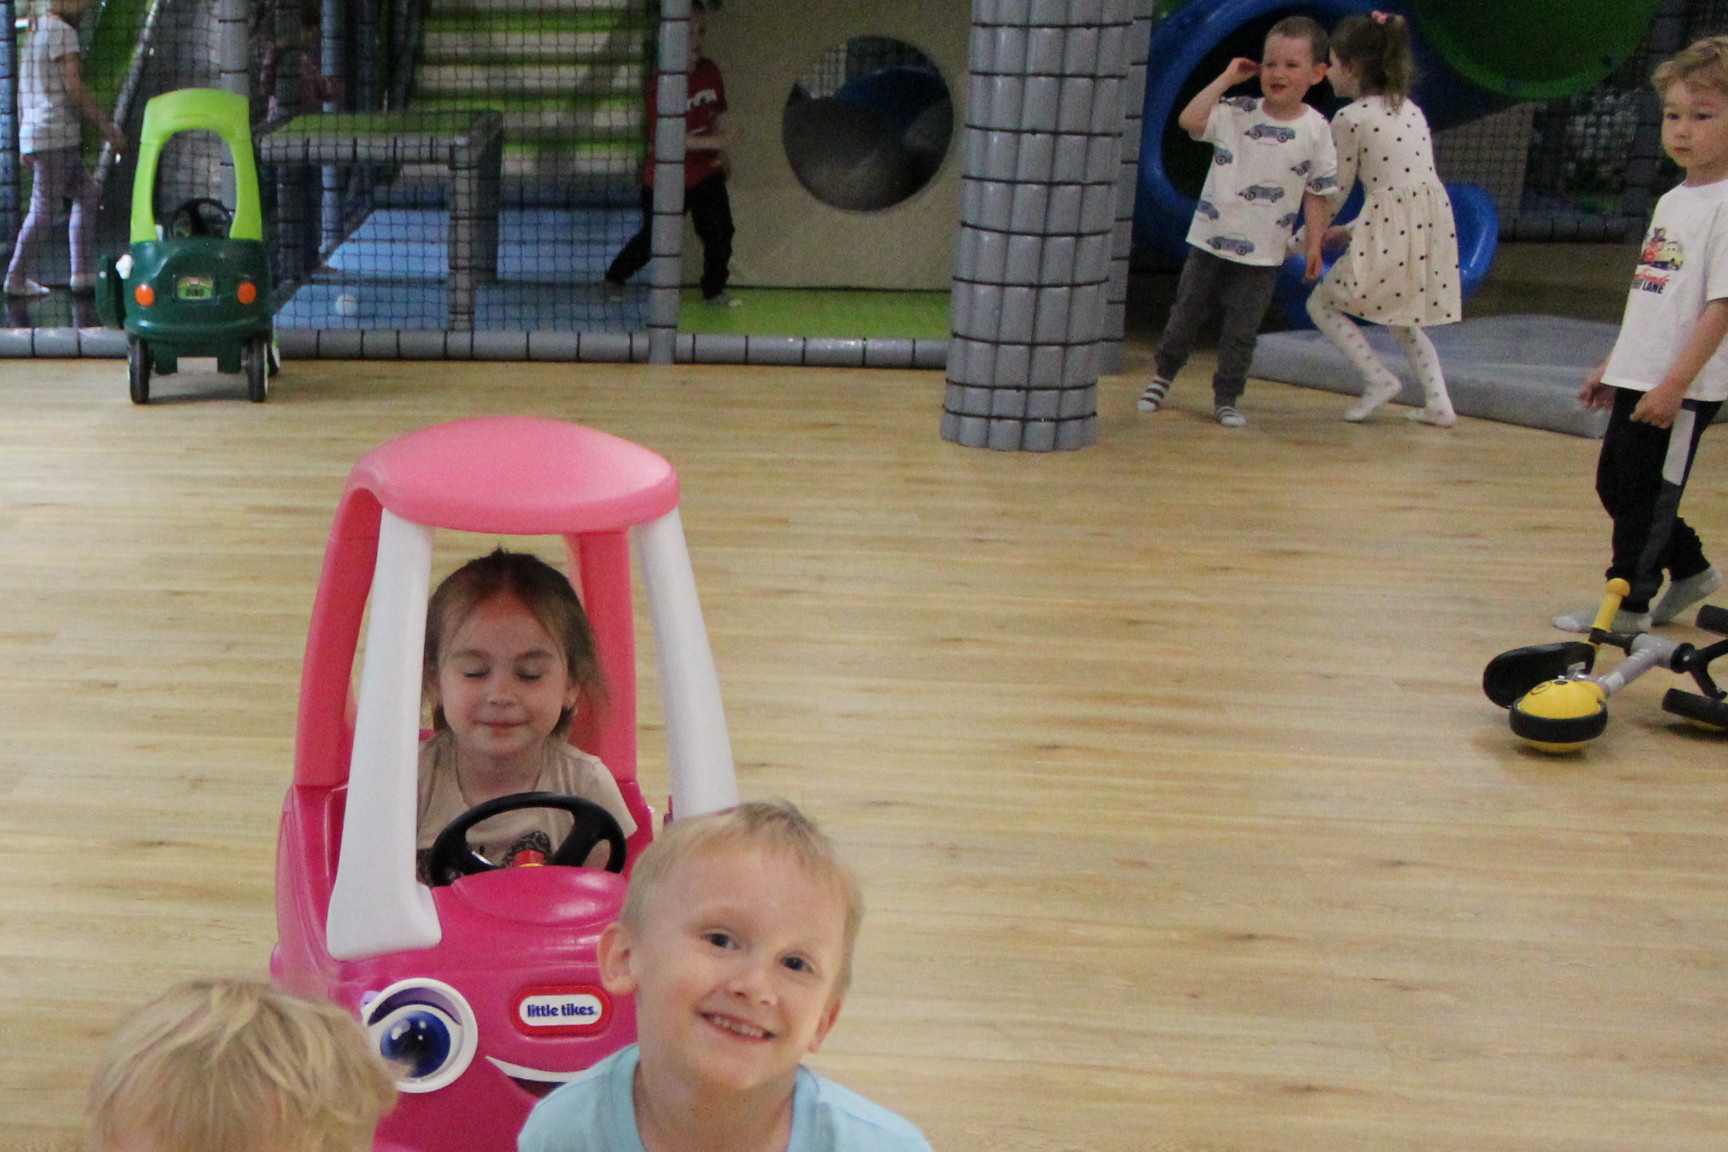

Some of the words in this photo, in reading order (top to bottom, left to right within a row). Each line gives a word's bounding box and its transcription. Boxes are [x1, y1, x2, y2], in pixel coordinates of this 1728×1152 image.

[1642, 280, 1665, 294] LANE
[527, 1003, 559, 1018] little
[561, 1002, 595, 1016] tikes
